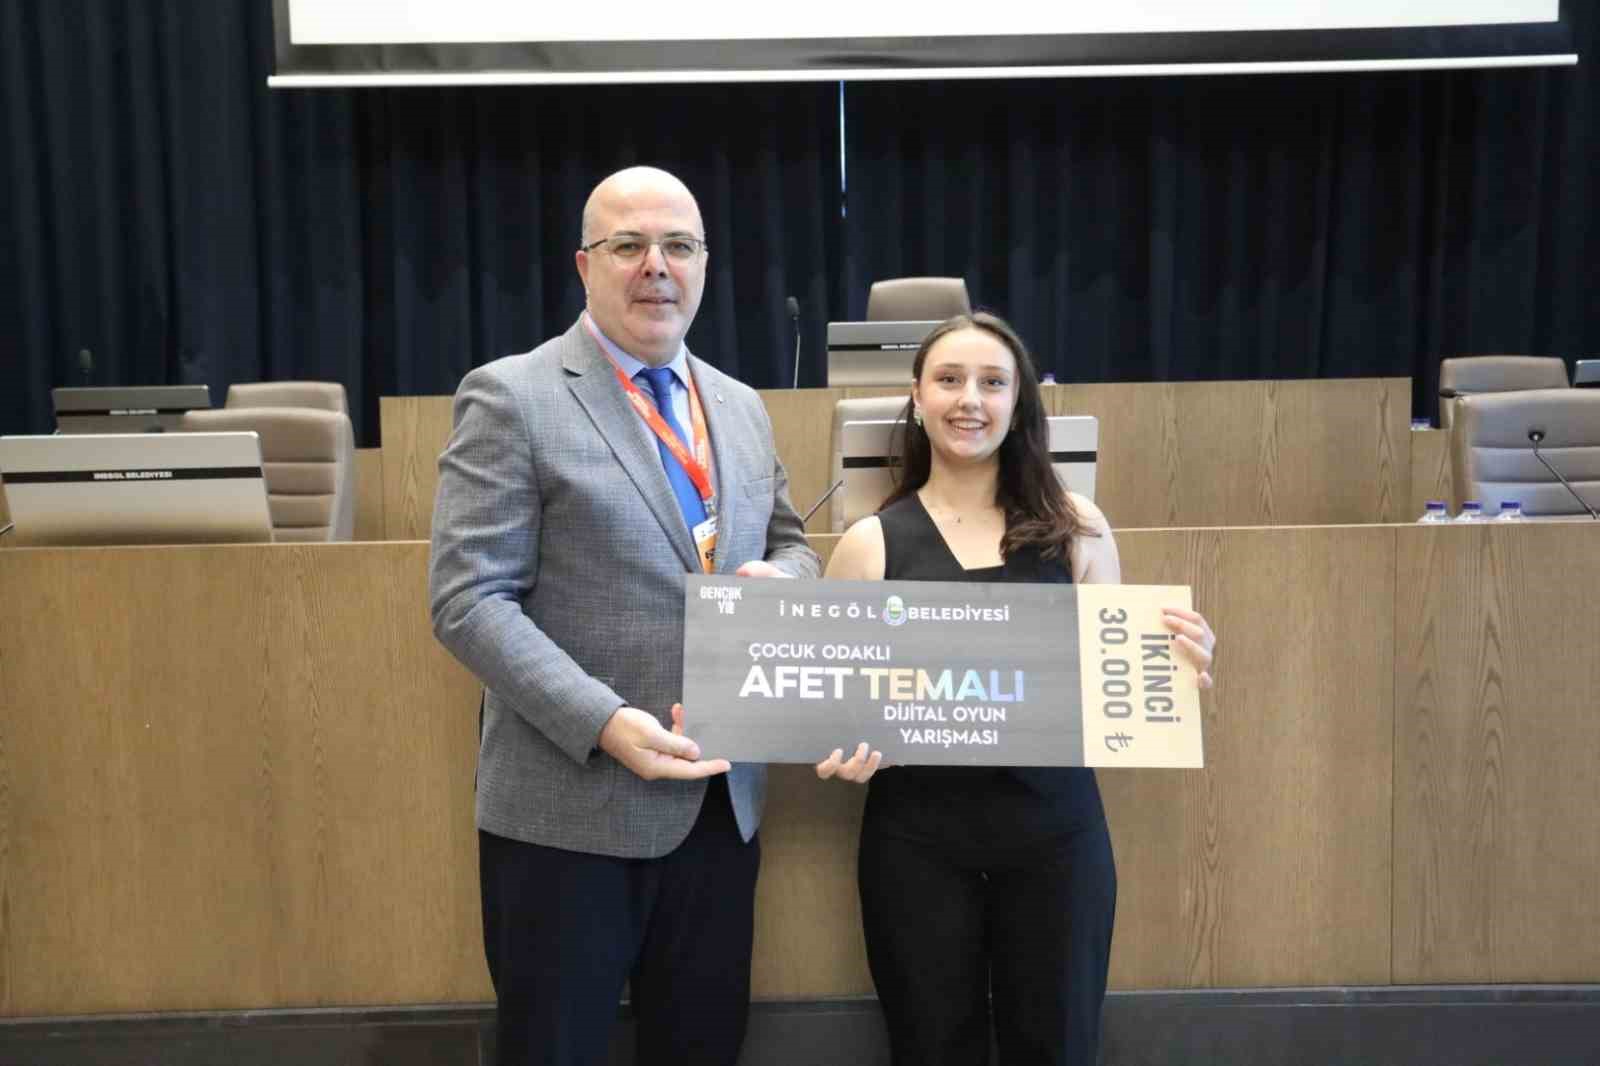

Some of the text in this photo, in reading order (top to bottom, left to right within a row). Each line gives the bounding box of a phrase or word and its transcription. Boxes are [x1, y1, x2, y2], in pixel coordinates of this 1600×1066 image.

[779, 600, 1010, 622] İNEGÖL BELEDİYESİ
[749, 643, 891, 661] ÇOCUK ODAKLI
[1099, 607, 1133, 719] 30.000
[739, 666, 1025, 702] AFET TEMALI
[1140, 633, 1181, 722] İKİNCİ
[953, 706, 1006, 723] OYUN
[900, 728, 999, 747] YARIŞMASI
